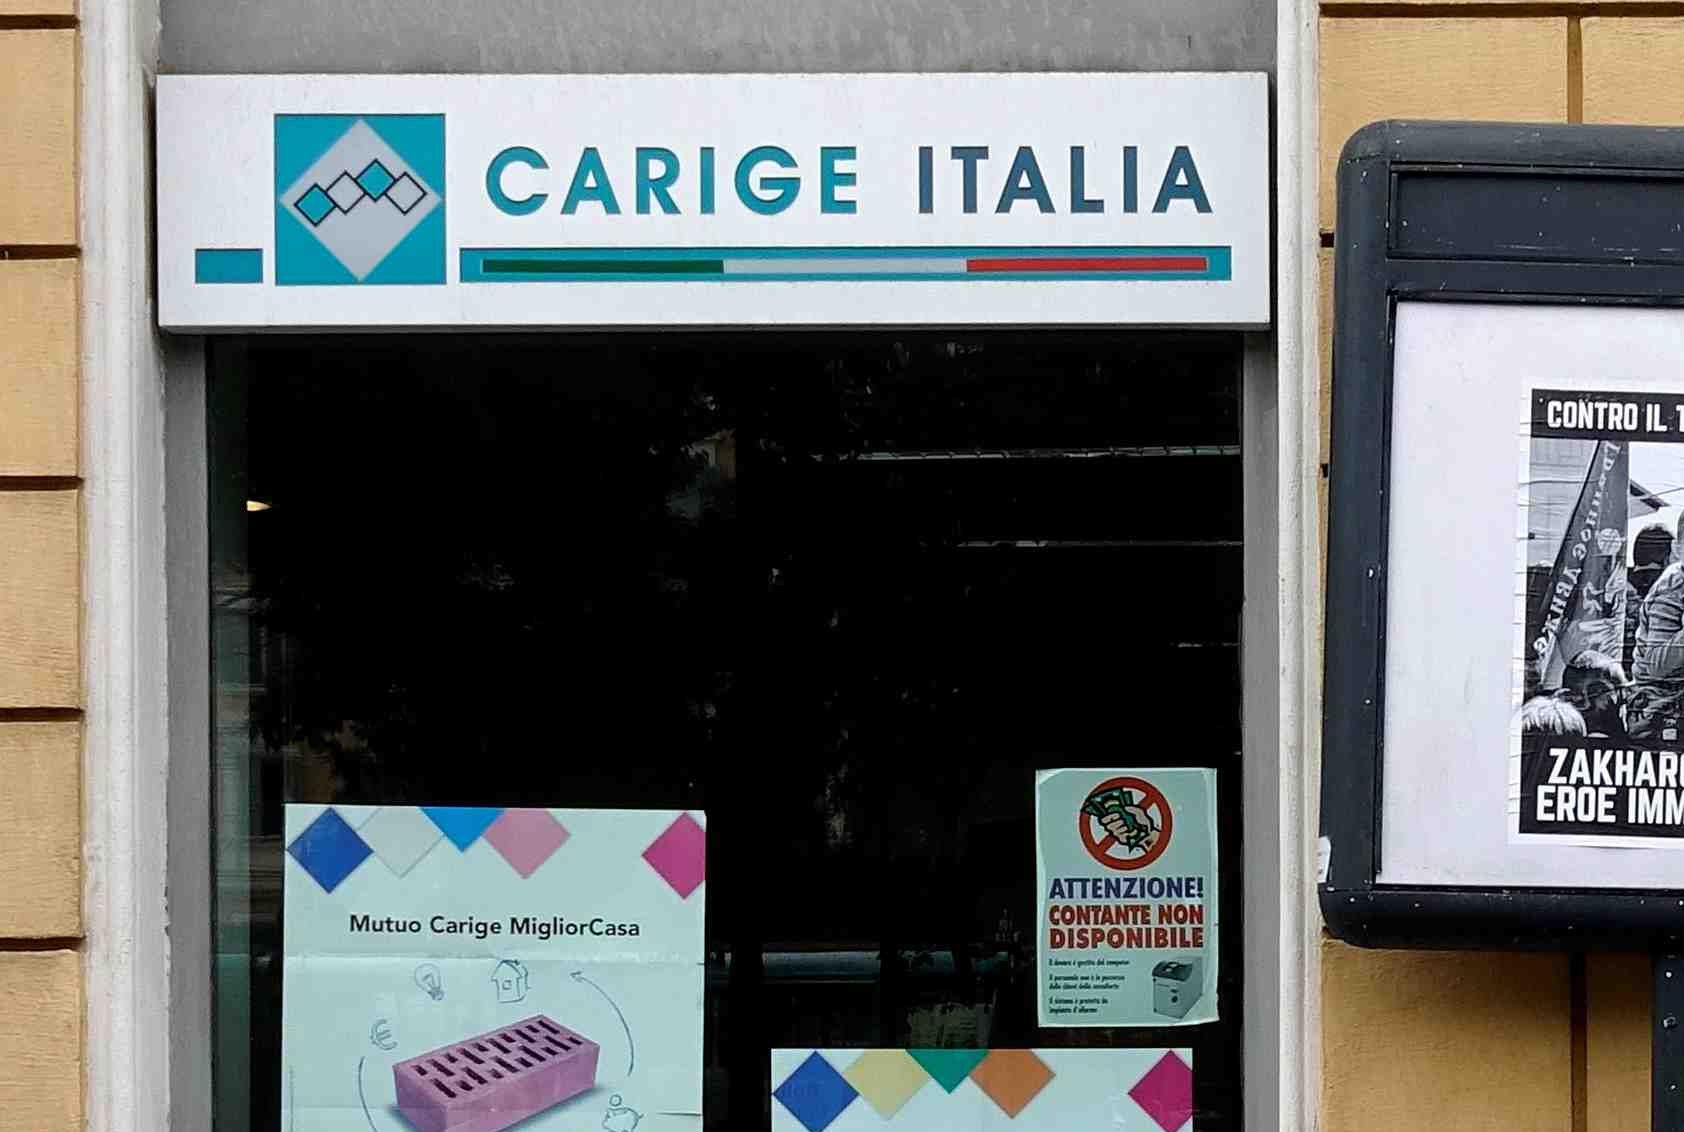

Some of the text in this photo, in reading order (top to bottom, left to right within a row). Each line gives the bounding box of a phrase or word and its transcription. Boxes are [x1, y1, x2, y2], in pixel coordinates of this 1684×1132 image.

[485, 145, 1214, 217] CARIGE ITALIA
[1547, 400, 1639, 431] CONTRO
[1646, 404, 1668, 433] IL
[1536, 785, 1616, 823] EROE
[1048, 876, 1204, 900] ATTENZIONE!
[349, 914, 641, 940] Mutuo Carige MigliorCasa
[1048, 904, 1204, 926] CONTANTE NON
[1049, 926, 1204, 950] DISPONIBILE
